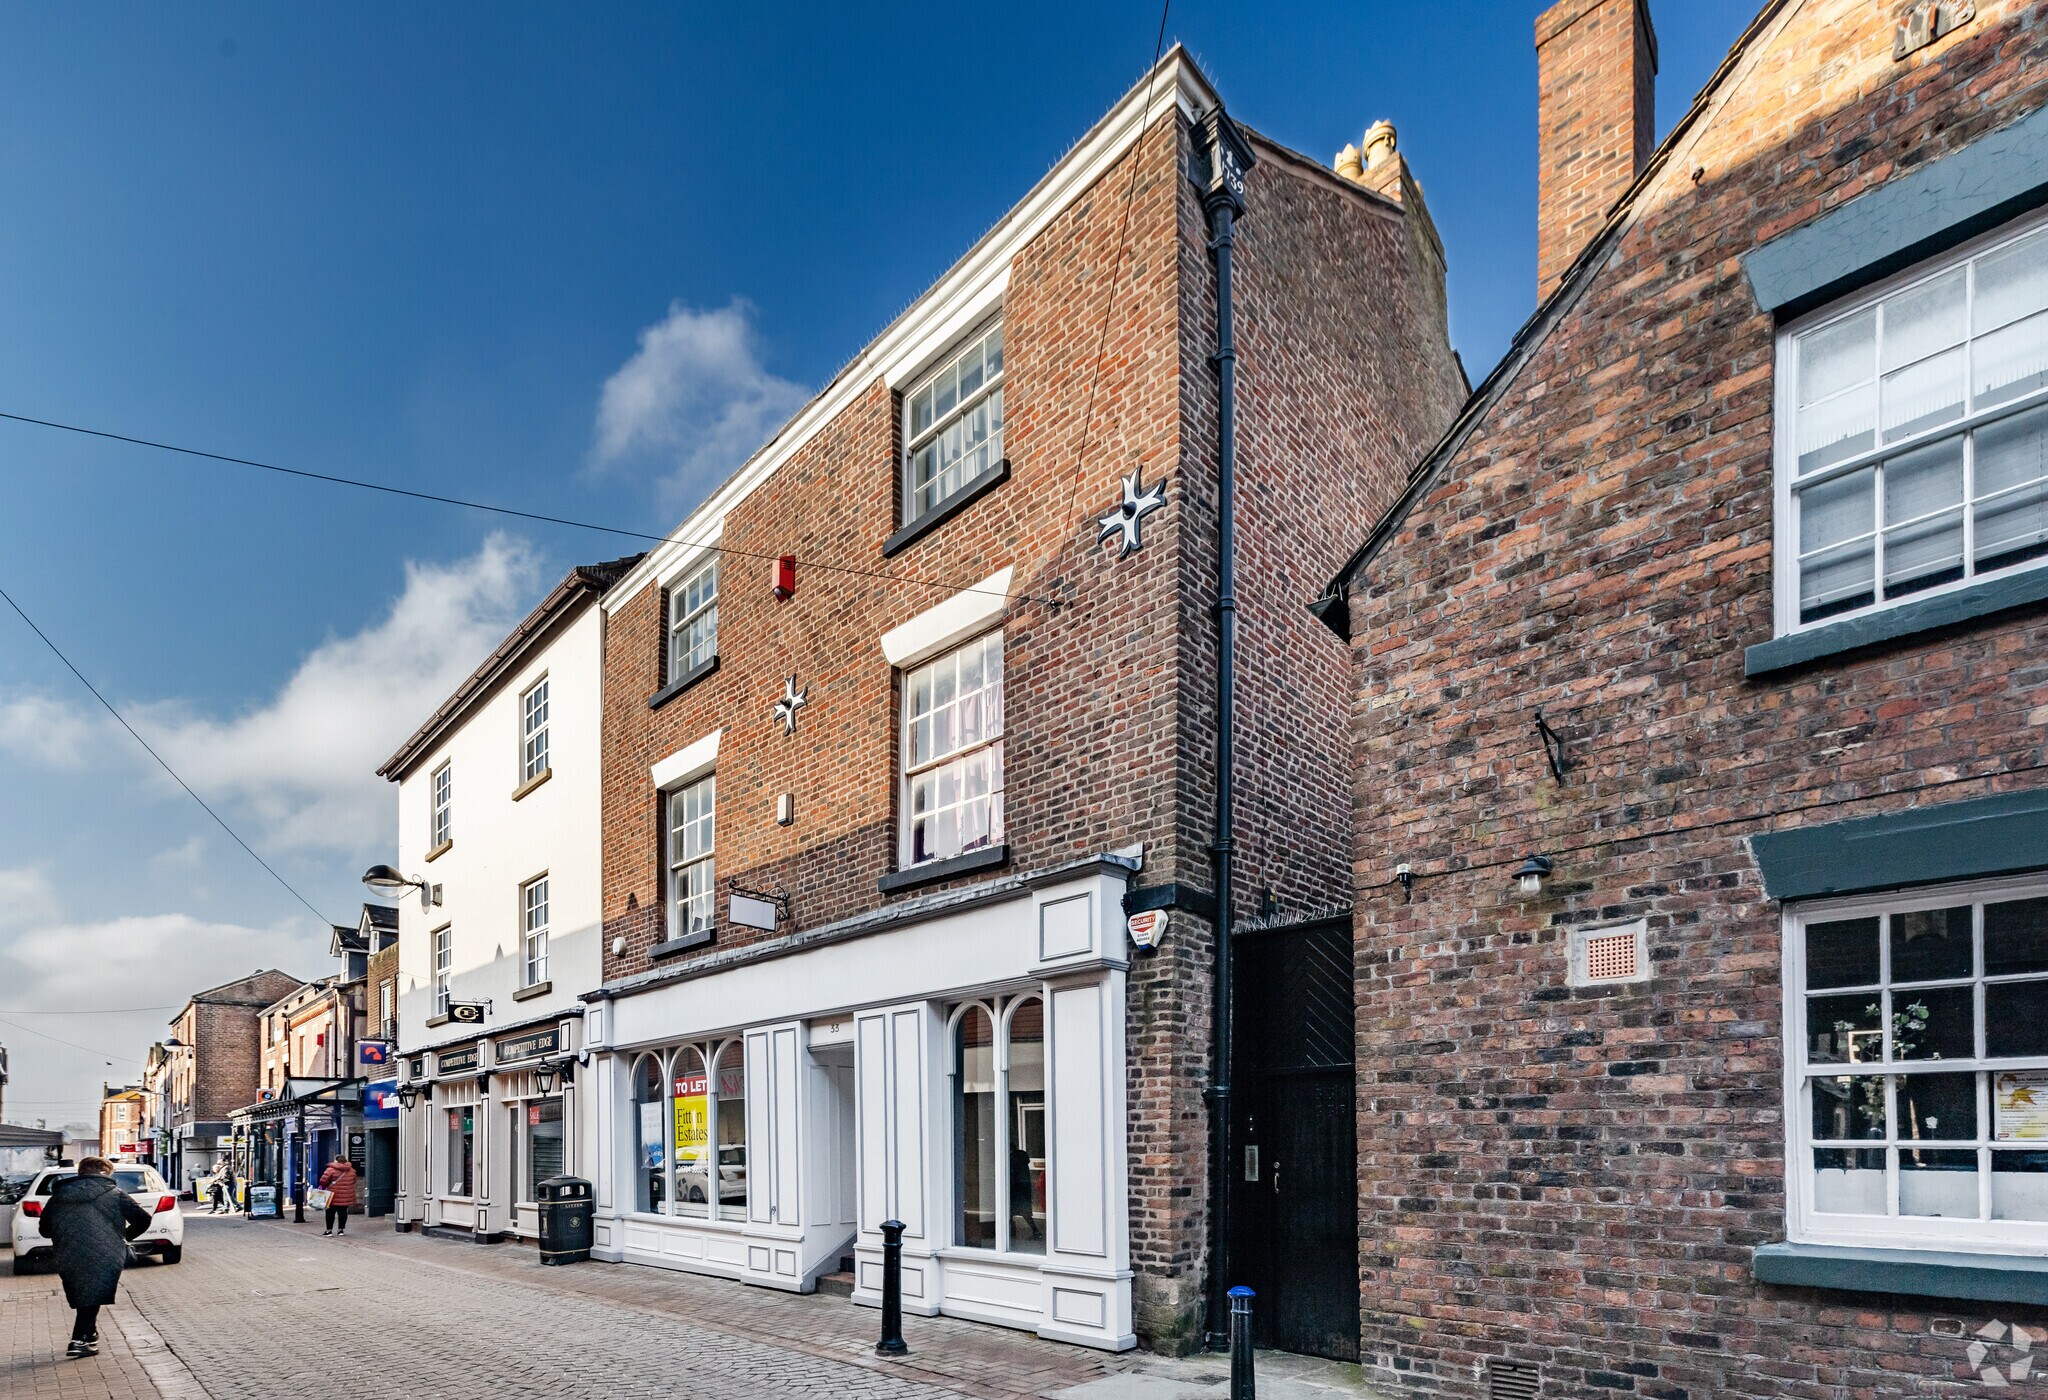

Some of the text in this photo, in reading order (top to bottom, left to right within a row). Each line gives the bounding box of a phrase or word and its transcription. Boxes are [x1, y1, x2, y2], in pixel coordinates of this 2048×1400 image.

[1130, 916, 1155, 926] SECURITY
[830, 1023, 840, 1033] 33
[504, 1036, 552, 1055] COMPETITIVE EDGE
[441, 1054, 466, 1068] COMPETITIVE
[675, 1081, 688, 1094] TO
[690, 1079, 707, 1093] LET
[677, 1125, 708, 1142] Estates
